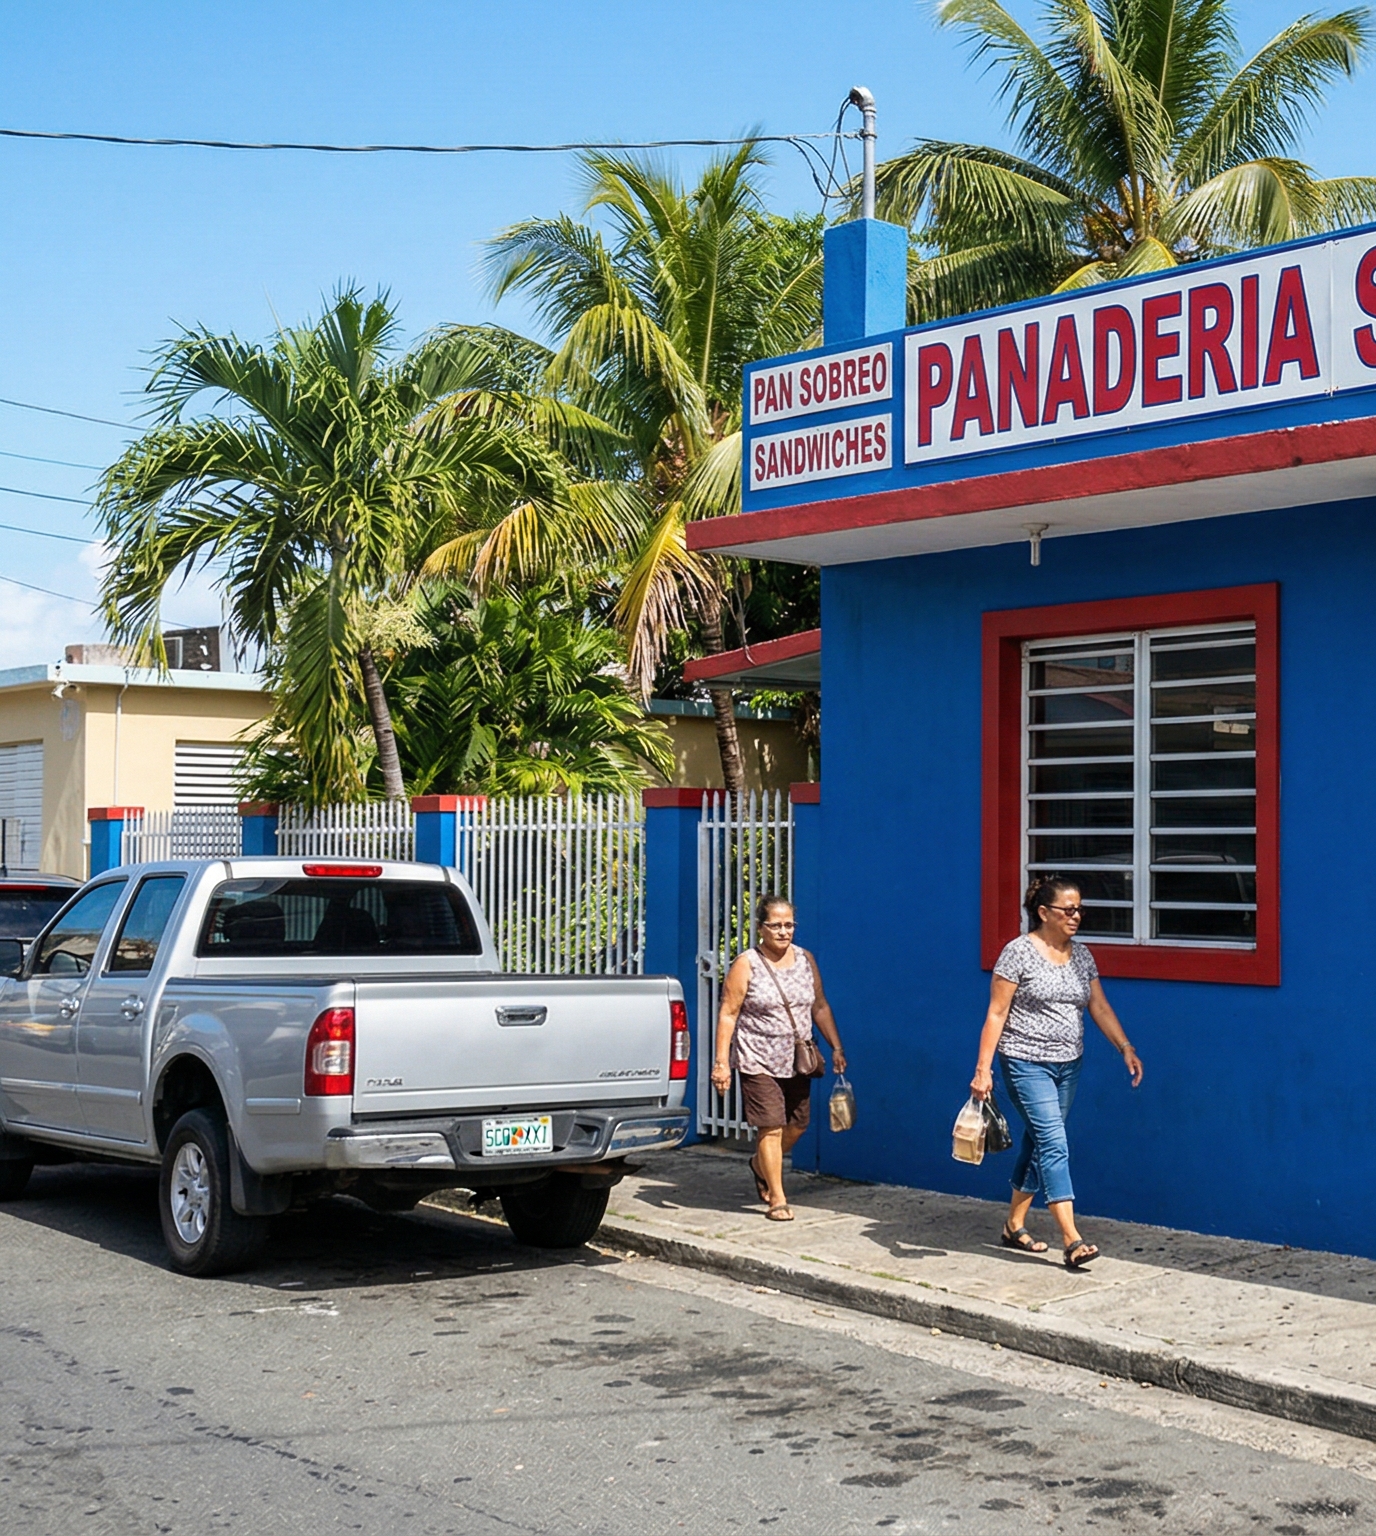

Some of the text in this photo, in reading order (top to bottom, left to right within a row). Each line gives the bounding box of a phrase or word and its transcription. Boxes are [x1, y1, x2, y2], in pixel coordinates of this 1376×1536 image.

[754, 352, 887, 416] PAN SOBREO
[917, 263, 1321, 448] PANADERIA
[754, 422, 887, 482] SANDWICHES
